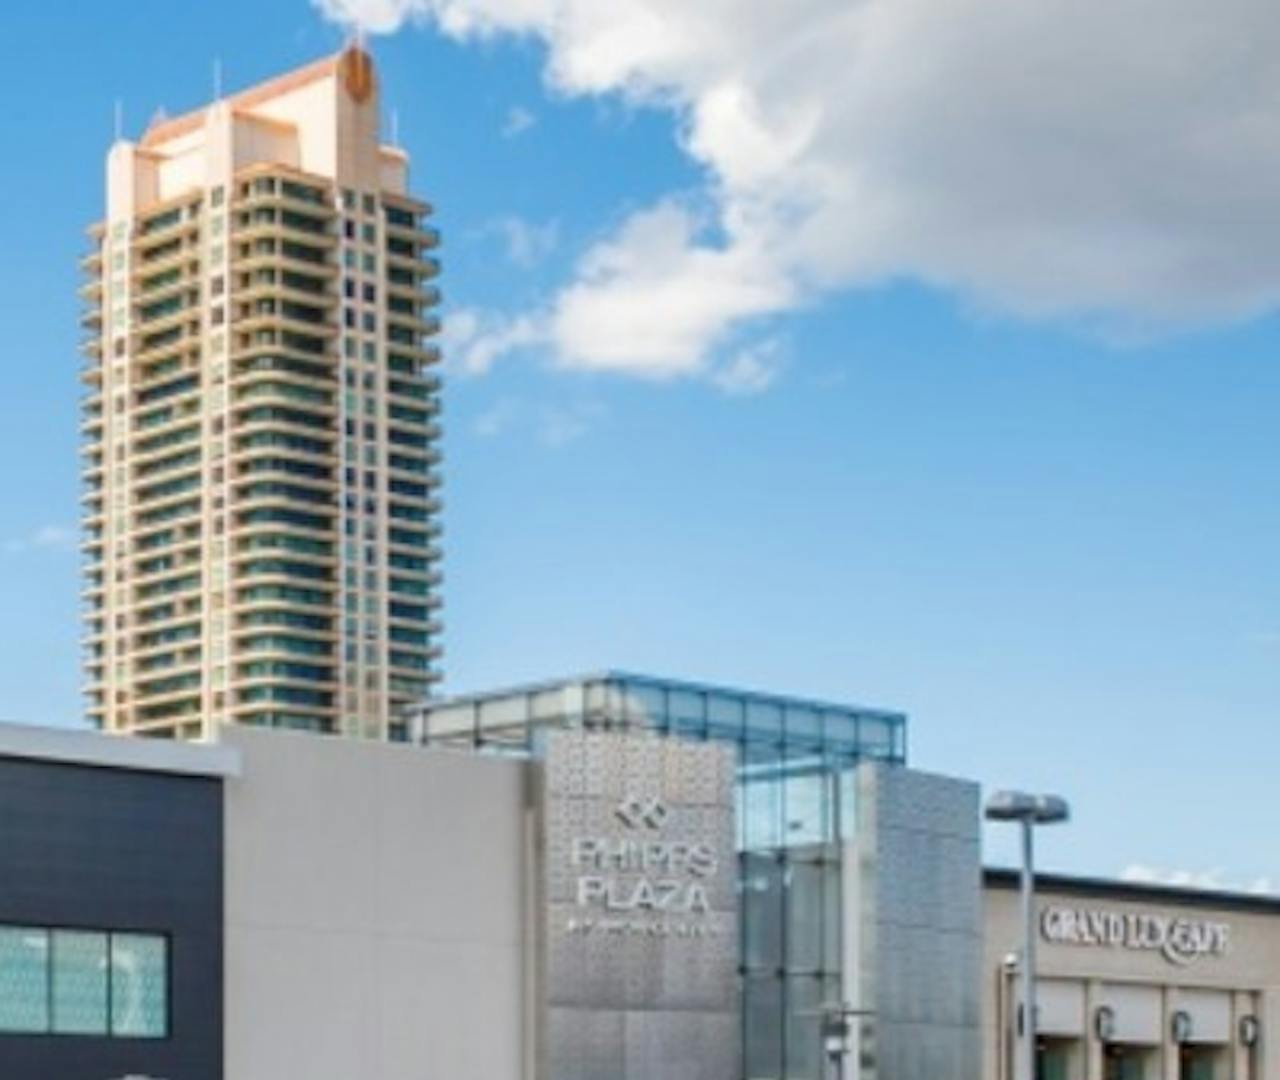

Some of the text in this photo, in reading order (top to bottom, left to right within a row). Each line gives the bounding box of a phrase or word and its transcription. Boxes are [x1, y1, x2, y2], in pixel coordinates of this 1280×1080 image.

[572, 838, 718, 877] PHIPPS
[578, 876, 710, 912] PLAZA
[1040, 906, 1124, 946] GRAND
